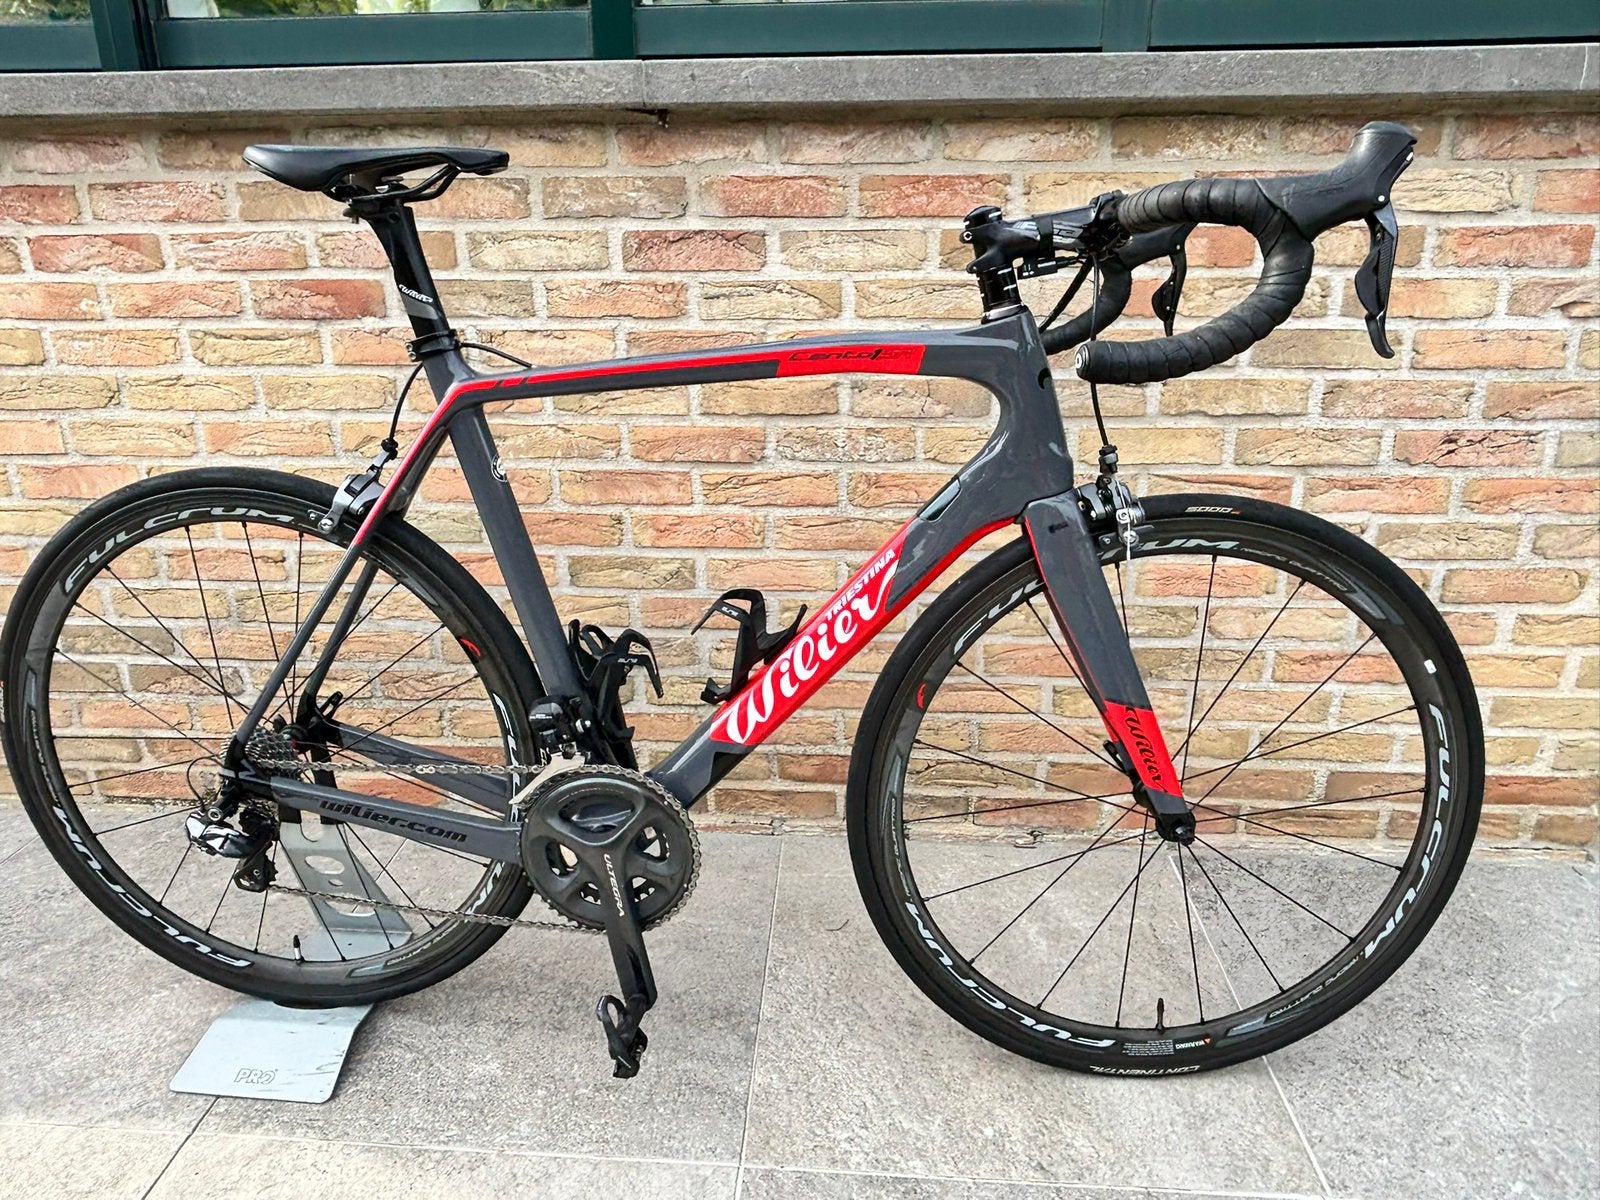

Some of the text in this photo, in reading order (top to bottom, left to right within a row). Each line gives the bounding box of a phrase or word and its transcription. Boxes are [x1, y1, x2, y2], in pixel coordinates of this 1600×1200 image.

[64, 507, 294, 593] FULCRUM
[1184, 506, 1233, 514] 5000
[825, 549, 896, 621] TRIESTINA
[710, 559, 899, 744] Wilier
[1124, 706, 1168, 793] Wilier
[1365, 703, 1450, 959] FULCRUM
[53, 806, 251, 967] FULCRUM
[603, 853, 625, 917] ULTEGRA
[905, 902, 1116, 1048] FULCRUM
[233, 1067, 276, 1085] PRO
[1089, 1065, 1200, 1075] CONTINENTAL
